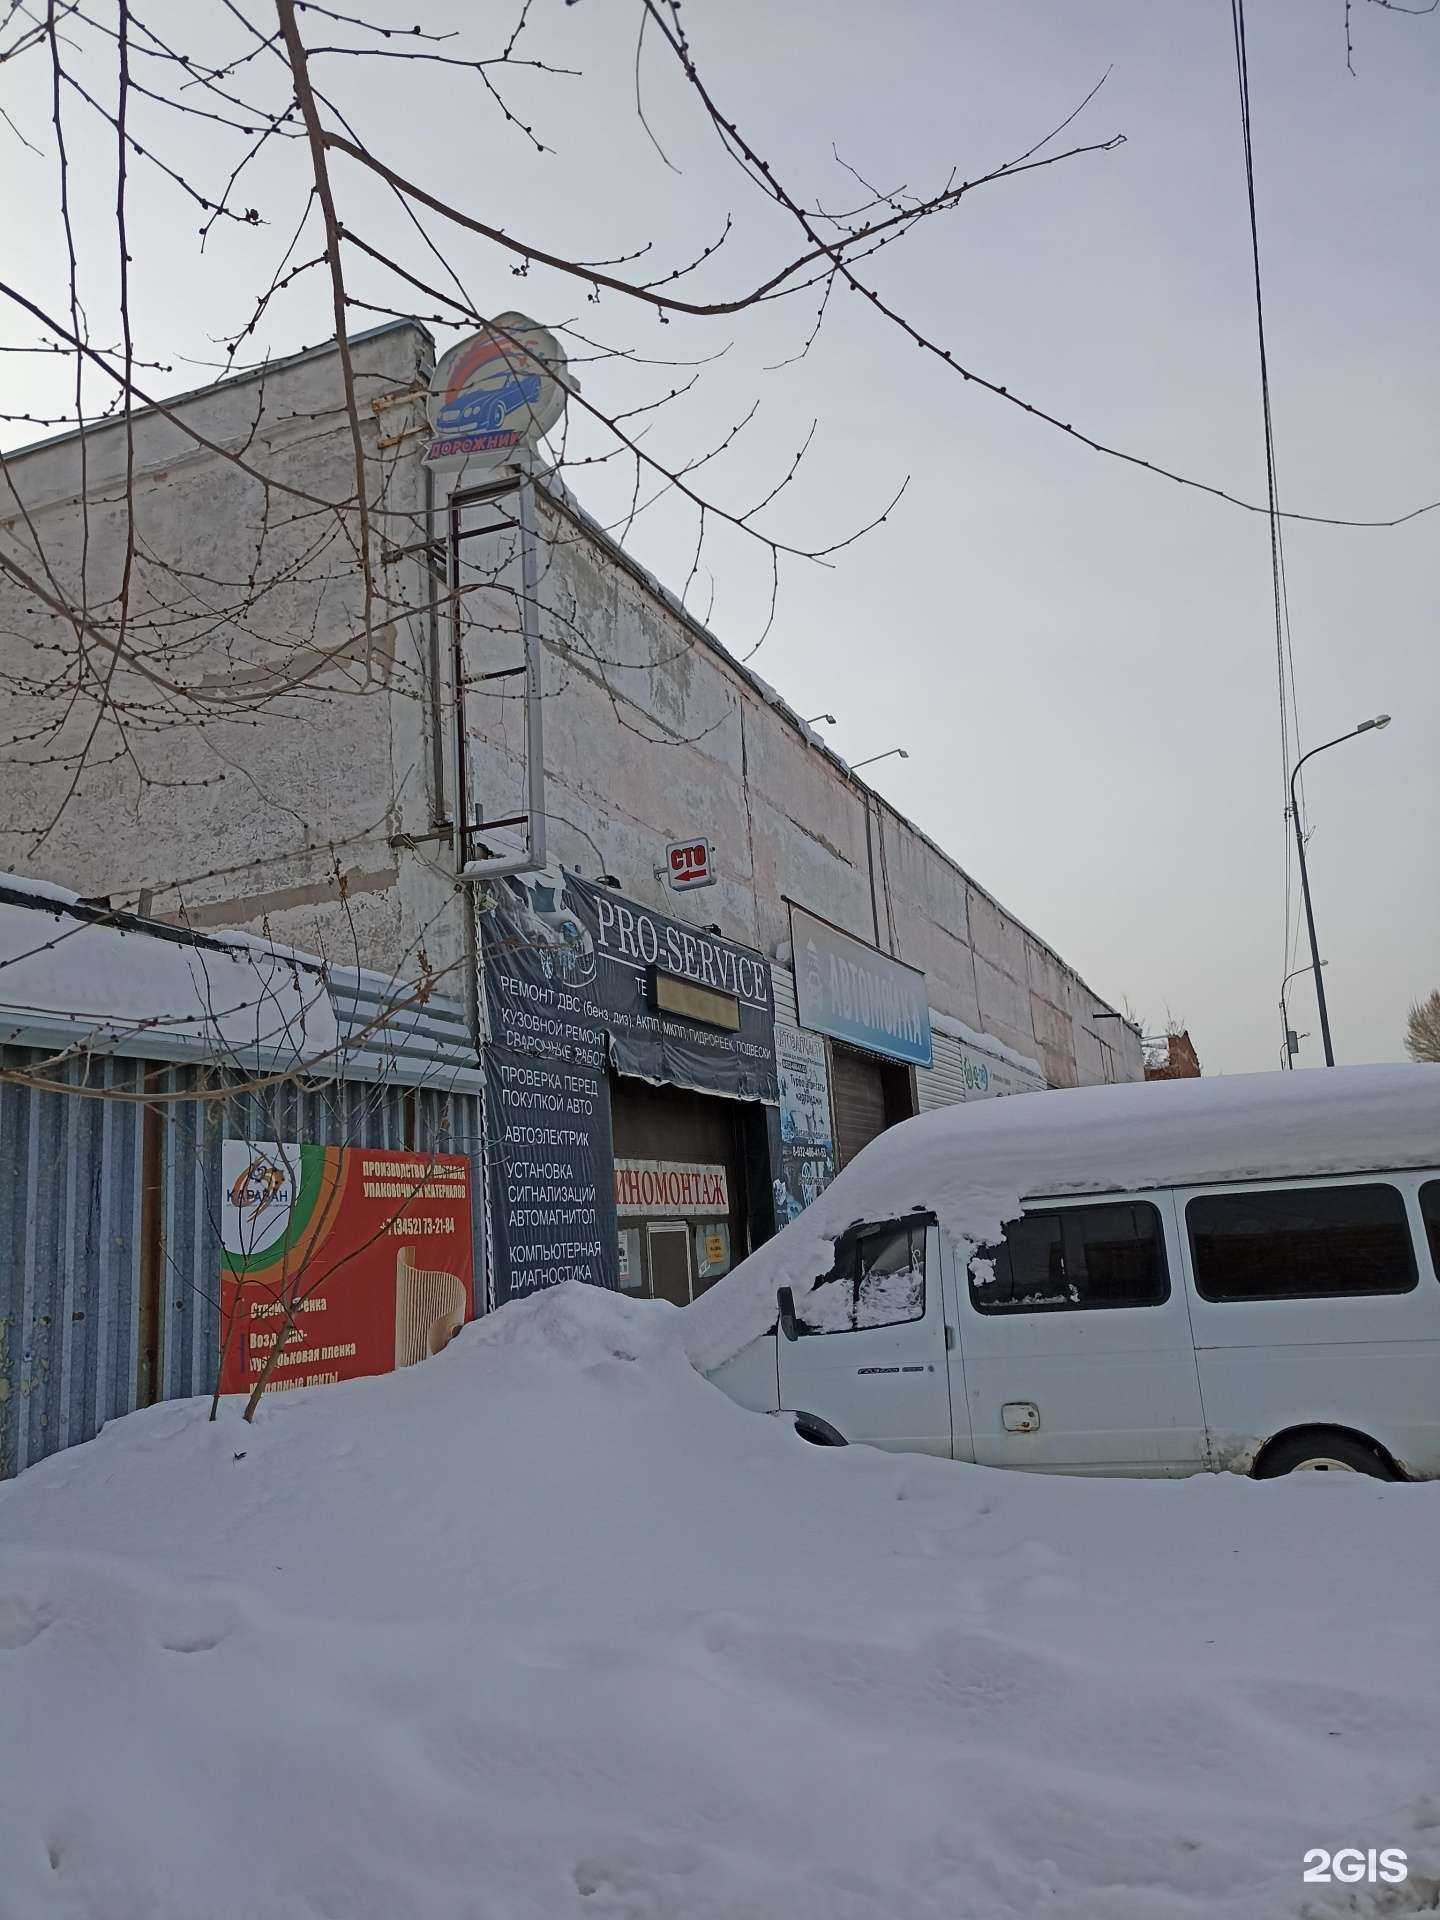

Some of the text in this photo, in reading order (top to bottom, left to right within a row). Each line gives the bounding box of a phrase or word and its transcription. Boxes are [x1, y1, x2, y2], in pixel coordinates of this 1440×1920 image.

[430, 430, 519, 460] ДОРОЖНИК
[671, 844, 706, 870] СТО
[593, 895, 767, 1001] PRO-SERVICE
[500, 975, 554, 1005] РЕМОНТ
[557, 992, 581, 1013] ДВС
[635, 977, 648, 997] ТЕ
[501, 1007, 606, 1046] КУЗОВНОЙ РЕМОНТ
[506, 1030, 606, 1067] СВАРОЧНЫЕ РАБОТ
[501, 1065, 598, 1098] ПРОВЕРКА ПЕРЕД
[502, 1089, 593, 1115] ПОКУПКОЙ АВТО
[504, 1126, 589, 1146] АВТОЭЛЕКТРИК
[362, 1161, 425, 1179] ПРОИЗВОДСТВО
[506, 1162, 573, 1179] УСТАНОВКА
[424, 1184, 466, 1199] МАТЕРИАЛОВ
[508, 1184, 596, 1205] СИГНАЛИЗАЦИЙ
[614, 1168, 727, 1206] ИНОМОНТАЖ
[393, 1217, 421, 1236] (3452)
[423, 1217, 455, 1234] 73-21-84
[509, 1208, 596, 1227] АВТОМАГНИТОЛ
[509, 1241, 601, 1263] КОМПЬЮТЕРНАЯ
[510, 1264, 592, 1291] ДИАГНОСТИКА
[321, 1342, 356, 1360] пленка
